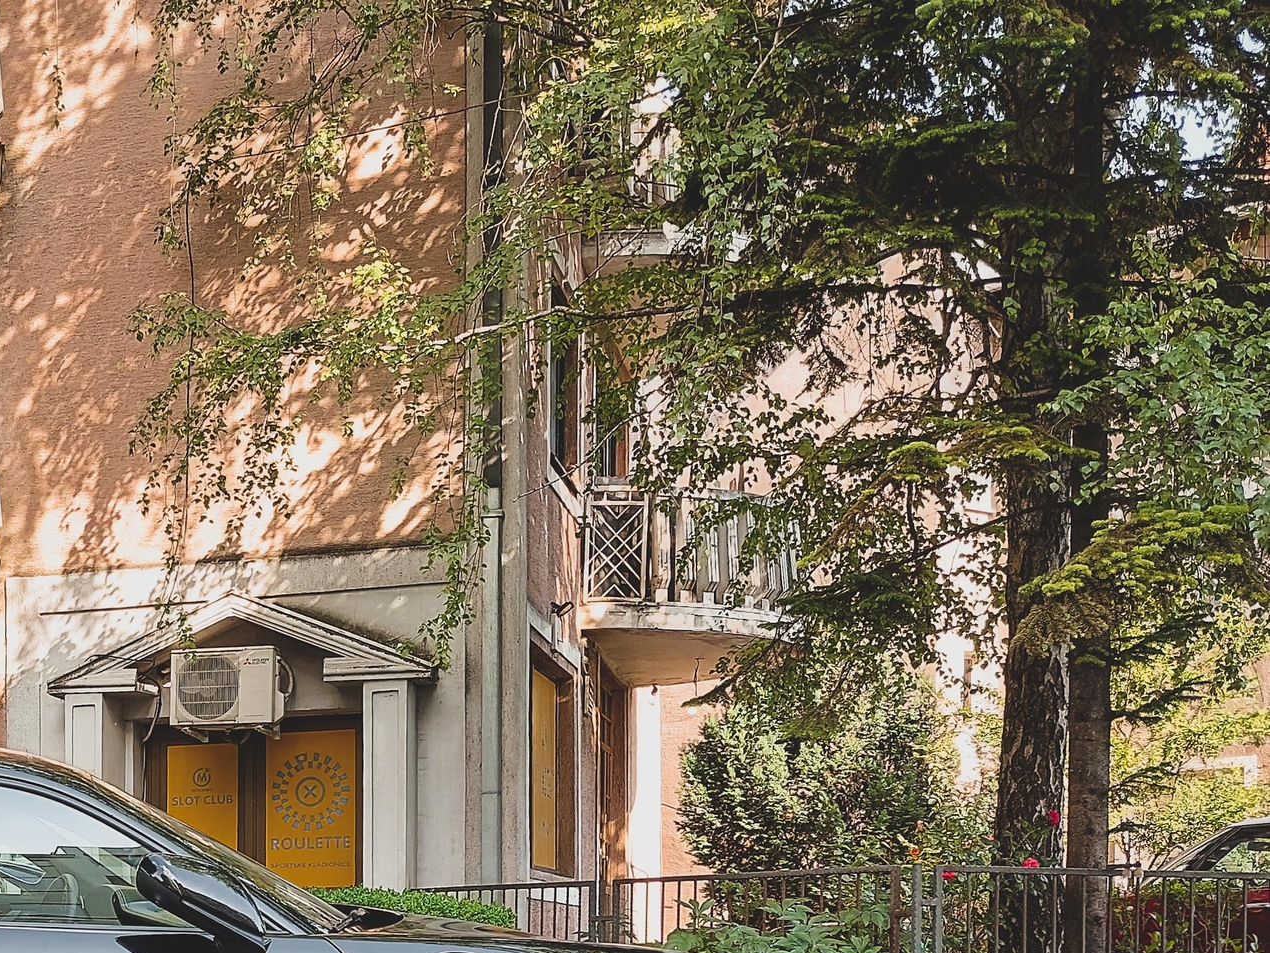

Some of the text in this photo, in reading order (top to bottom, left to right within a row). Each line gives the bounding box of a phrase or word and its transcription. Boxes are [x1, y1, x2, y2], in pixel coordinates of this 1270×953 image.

[171, 794, 234, 806] SLOT CLUB
[270, 836, 351, 851] ROULETTE
